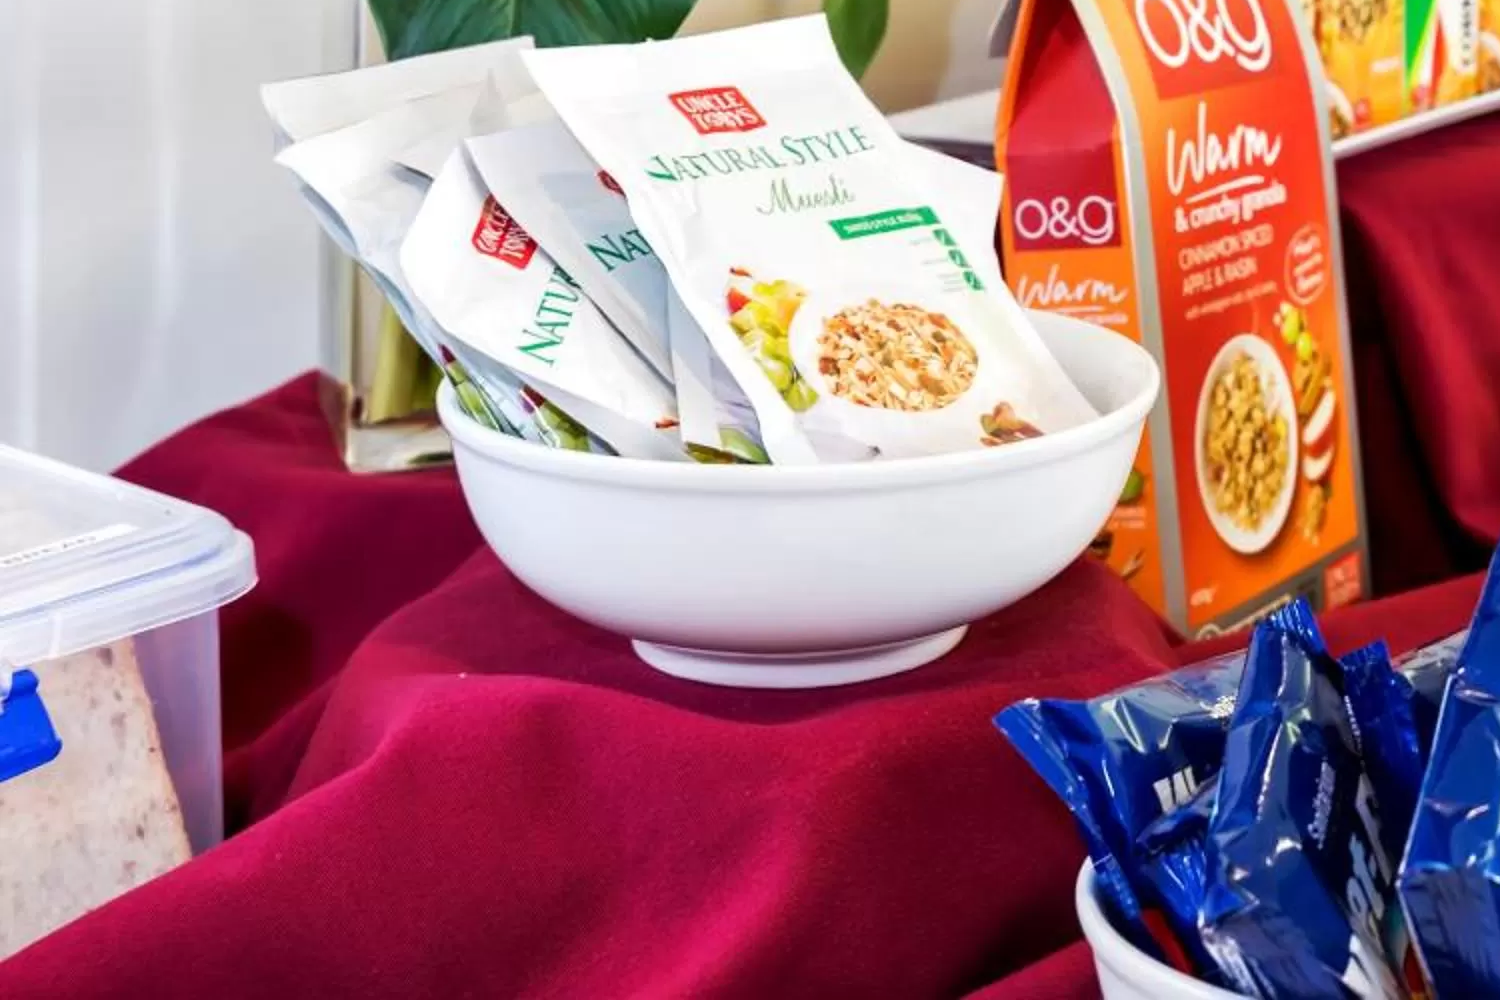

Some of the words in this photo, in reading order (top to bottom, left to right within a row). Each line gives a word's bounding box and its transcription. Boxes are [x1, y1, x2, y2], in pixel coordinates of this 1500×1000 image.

[675, 90, 745, 115] UNCLE
[645, 146, 788, 182] NATURAL
[779, 125, 876, 167] STYLE
[1166, 101, 1281, 197] Warm
[755, 174, 857, 217] Muesli
[1016, 263, 1130, 309] Warm
